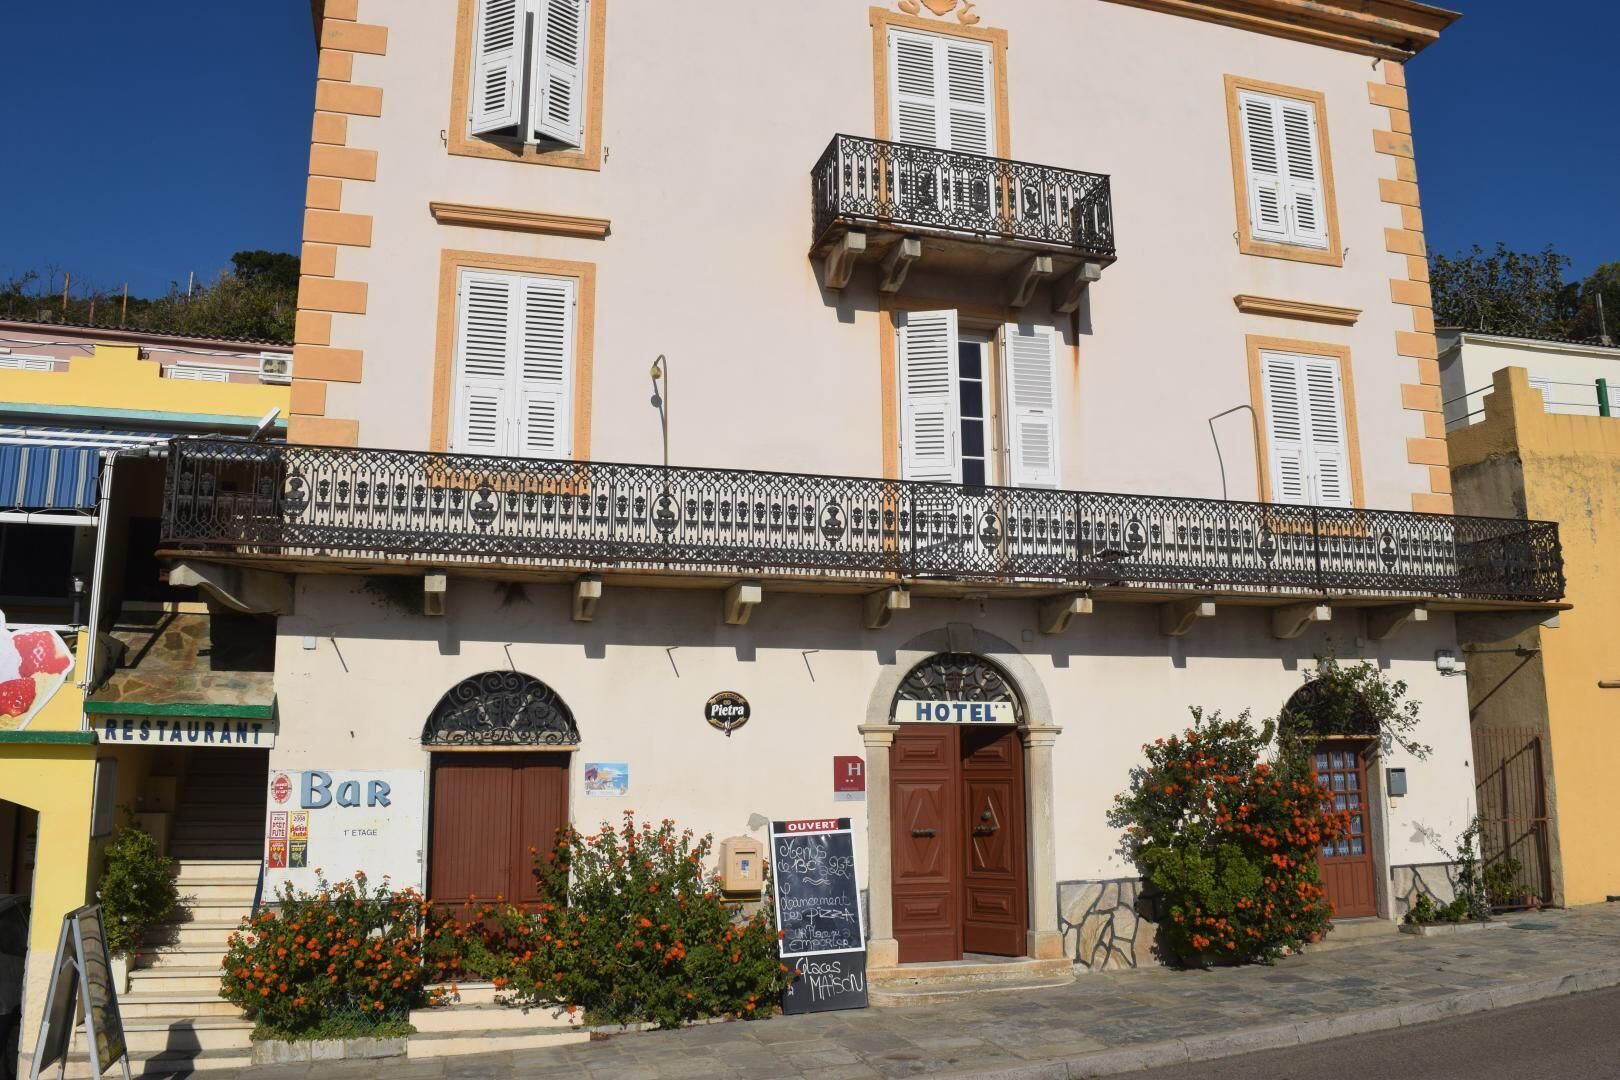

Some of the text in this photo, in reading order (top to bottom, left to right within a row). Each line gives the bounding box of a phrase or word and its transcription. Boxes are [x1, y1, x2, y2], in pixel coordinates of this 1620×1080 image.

[711, 704, 745, 717] Pietra
[916, 702, 997, 722] HOTEL
[105, 719, 263, 745] RESTAURANT
[848, 762, 861, 776] H
[788, 821, 836, 831] OUVERT
